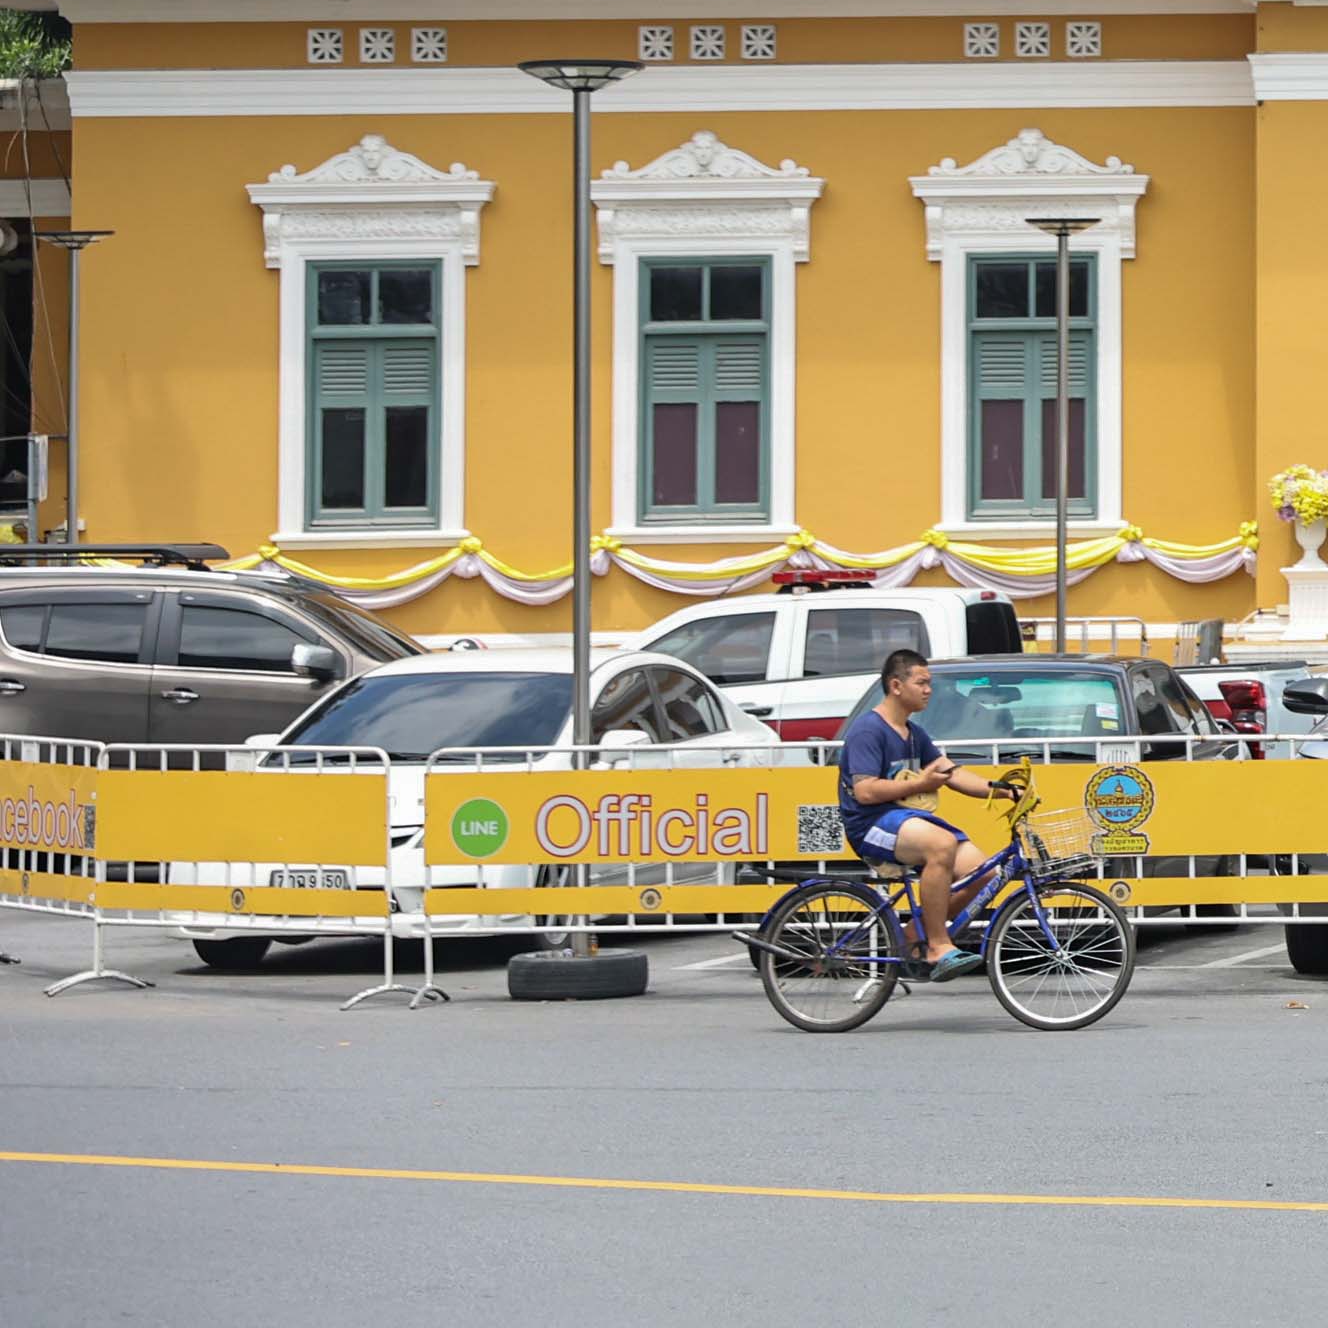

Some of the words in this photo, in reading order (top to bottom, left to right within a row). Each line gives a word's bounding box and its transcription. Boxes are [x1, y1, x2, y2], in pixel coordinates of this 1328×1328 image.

[0, 784, 84, 849] cebook
[460, 820, 499, 835] LINE
[535, 792, 769, 858] Official
